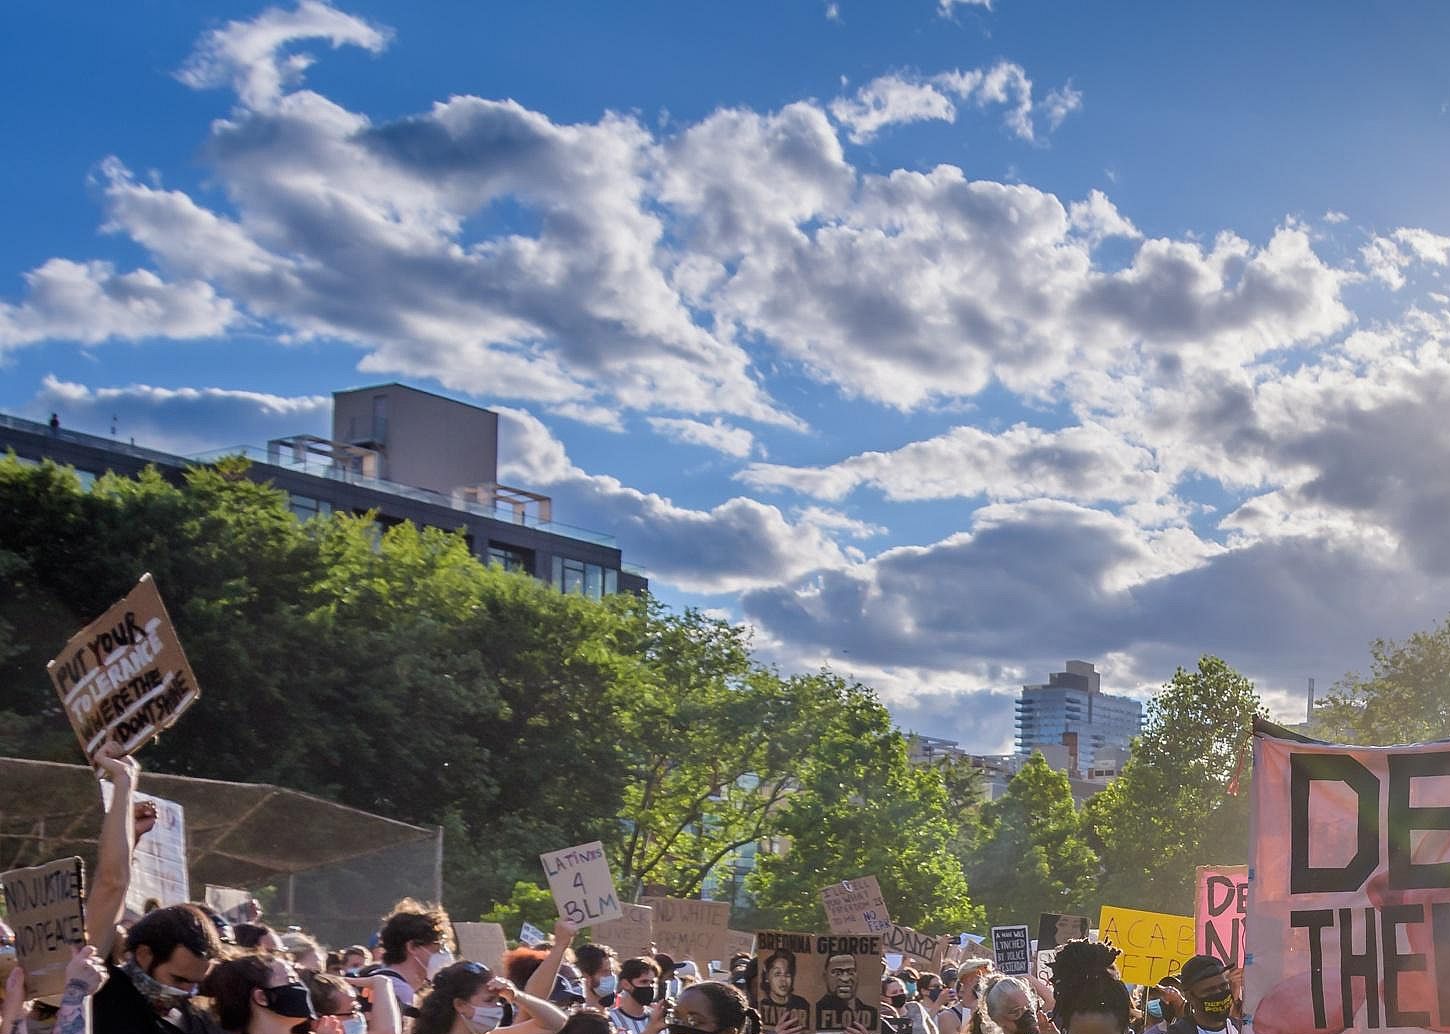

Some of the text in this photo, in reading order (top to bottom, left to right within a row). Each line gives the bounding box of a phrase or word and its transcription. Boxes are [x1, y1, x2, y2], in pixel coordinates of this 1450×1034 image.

[55, 611, 148, 696] PUT YOUR
[70, 630, 164, 724] TOLERANCE
[127, 667, 162, 700] THE
[3, 868, 80, 914] NO JUSTICE
[572, 871, 587, 895] 4
[564, 894, 618, 924] BLM
[15, 915, 84, 957] NO PEACE
[816, 936, 880, 955] GEORGE
[1104, 917, 1194, 956] ACAB
[1291, 904, 1432, 1030] THE
[820, 1009, 873, 1029] FLOYD
